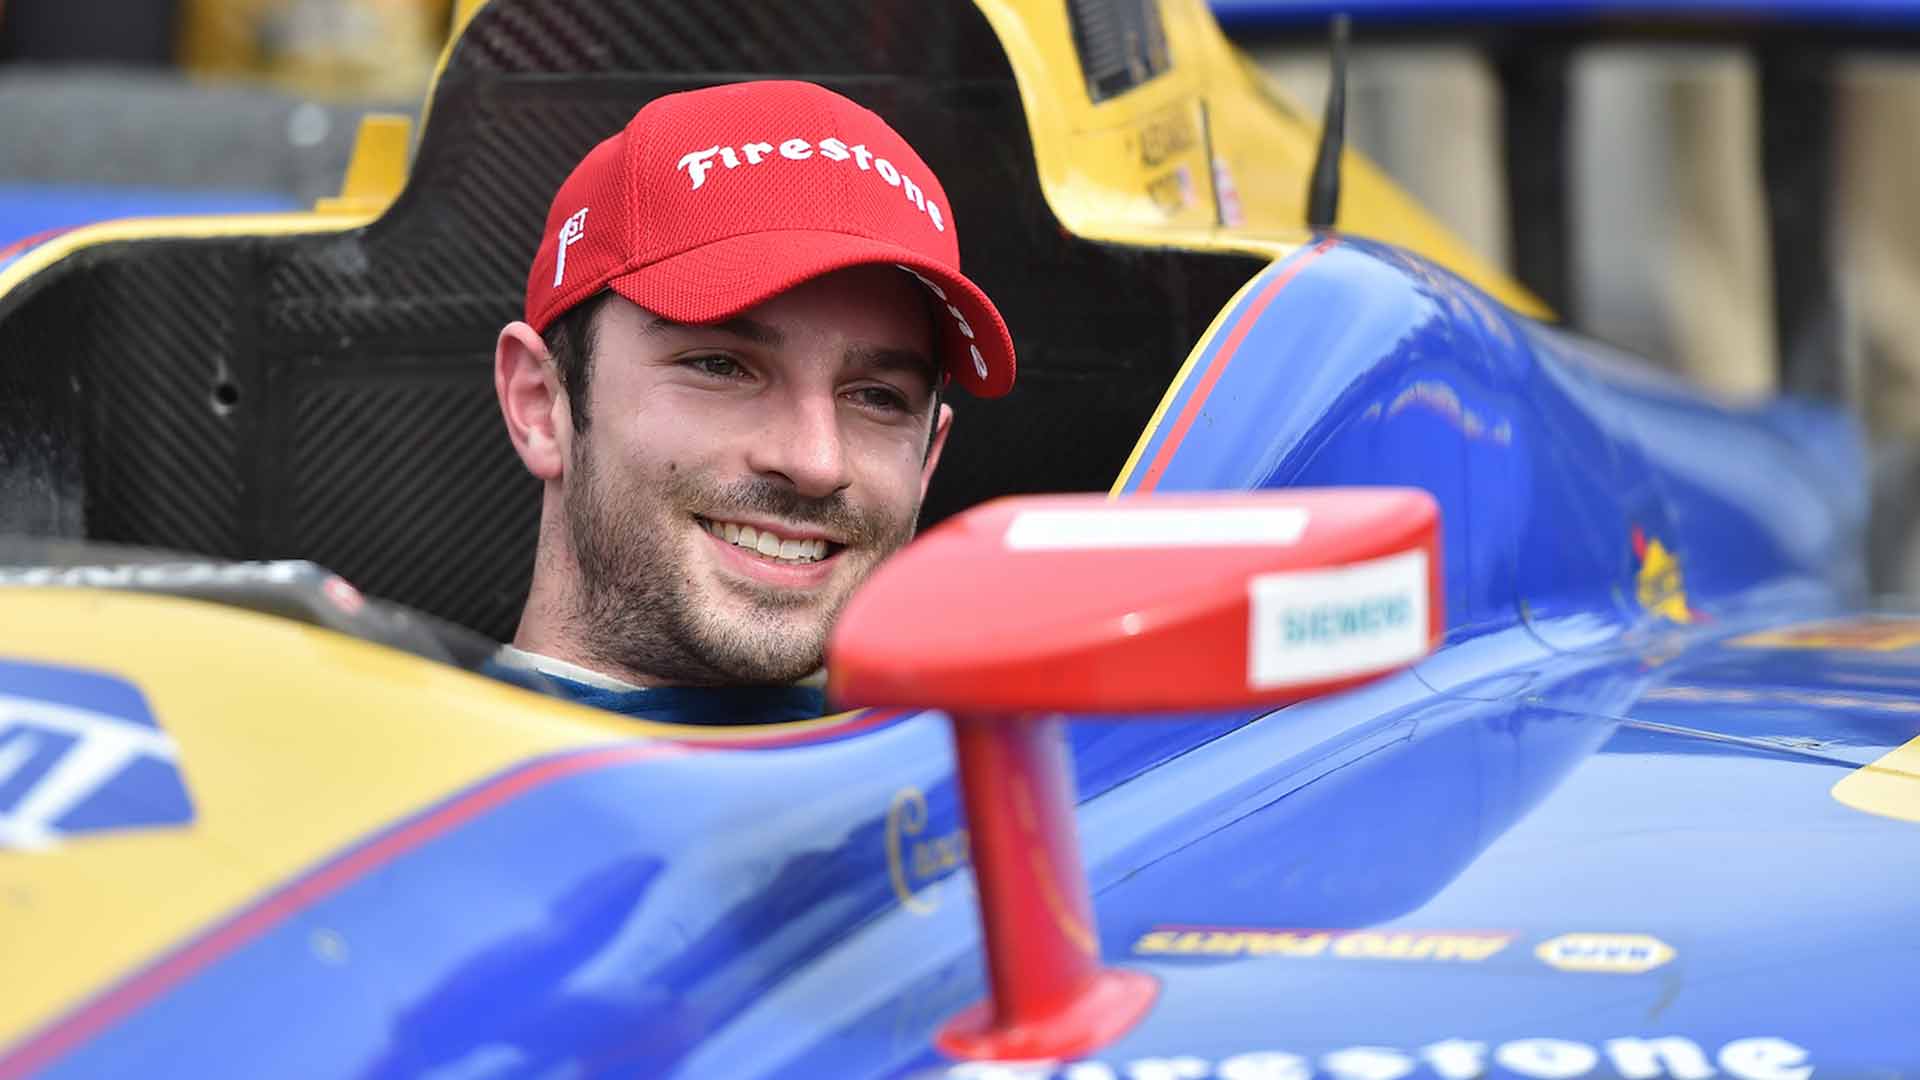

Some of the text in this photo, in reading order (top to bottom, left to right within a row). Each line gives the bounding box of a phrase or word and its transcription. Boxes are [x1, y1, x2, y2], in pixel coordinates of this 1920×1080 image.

[677, 138, 945, 232] Firestone
[1280, 594, 1411, 644] SIEMENS
[1134, 931, 1331, 957] PARTS
[1333, 933, 1510, 961] AUTO
